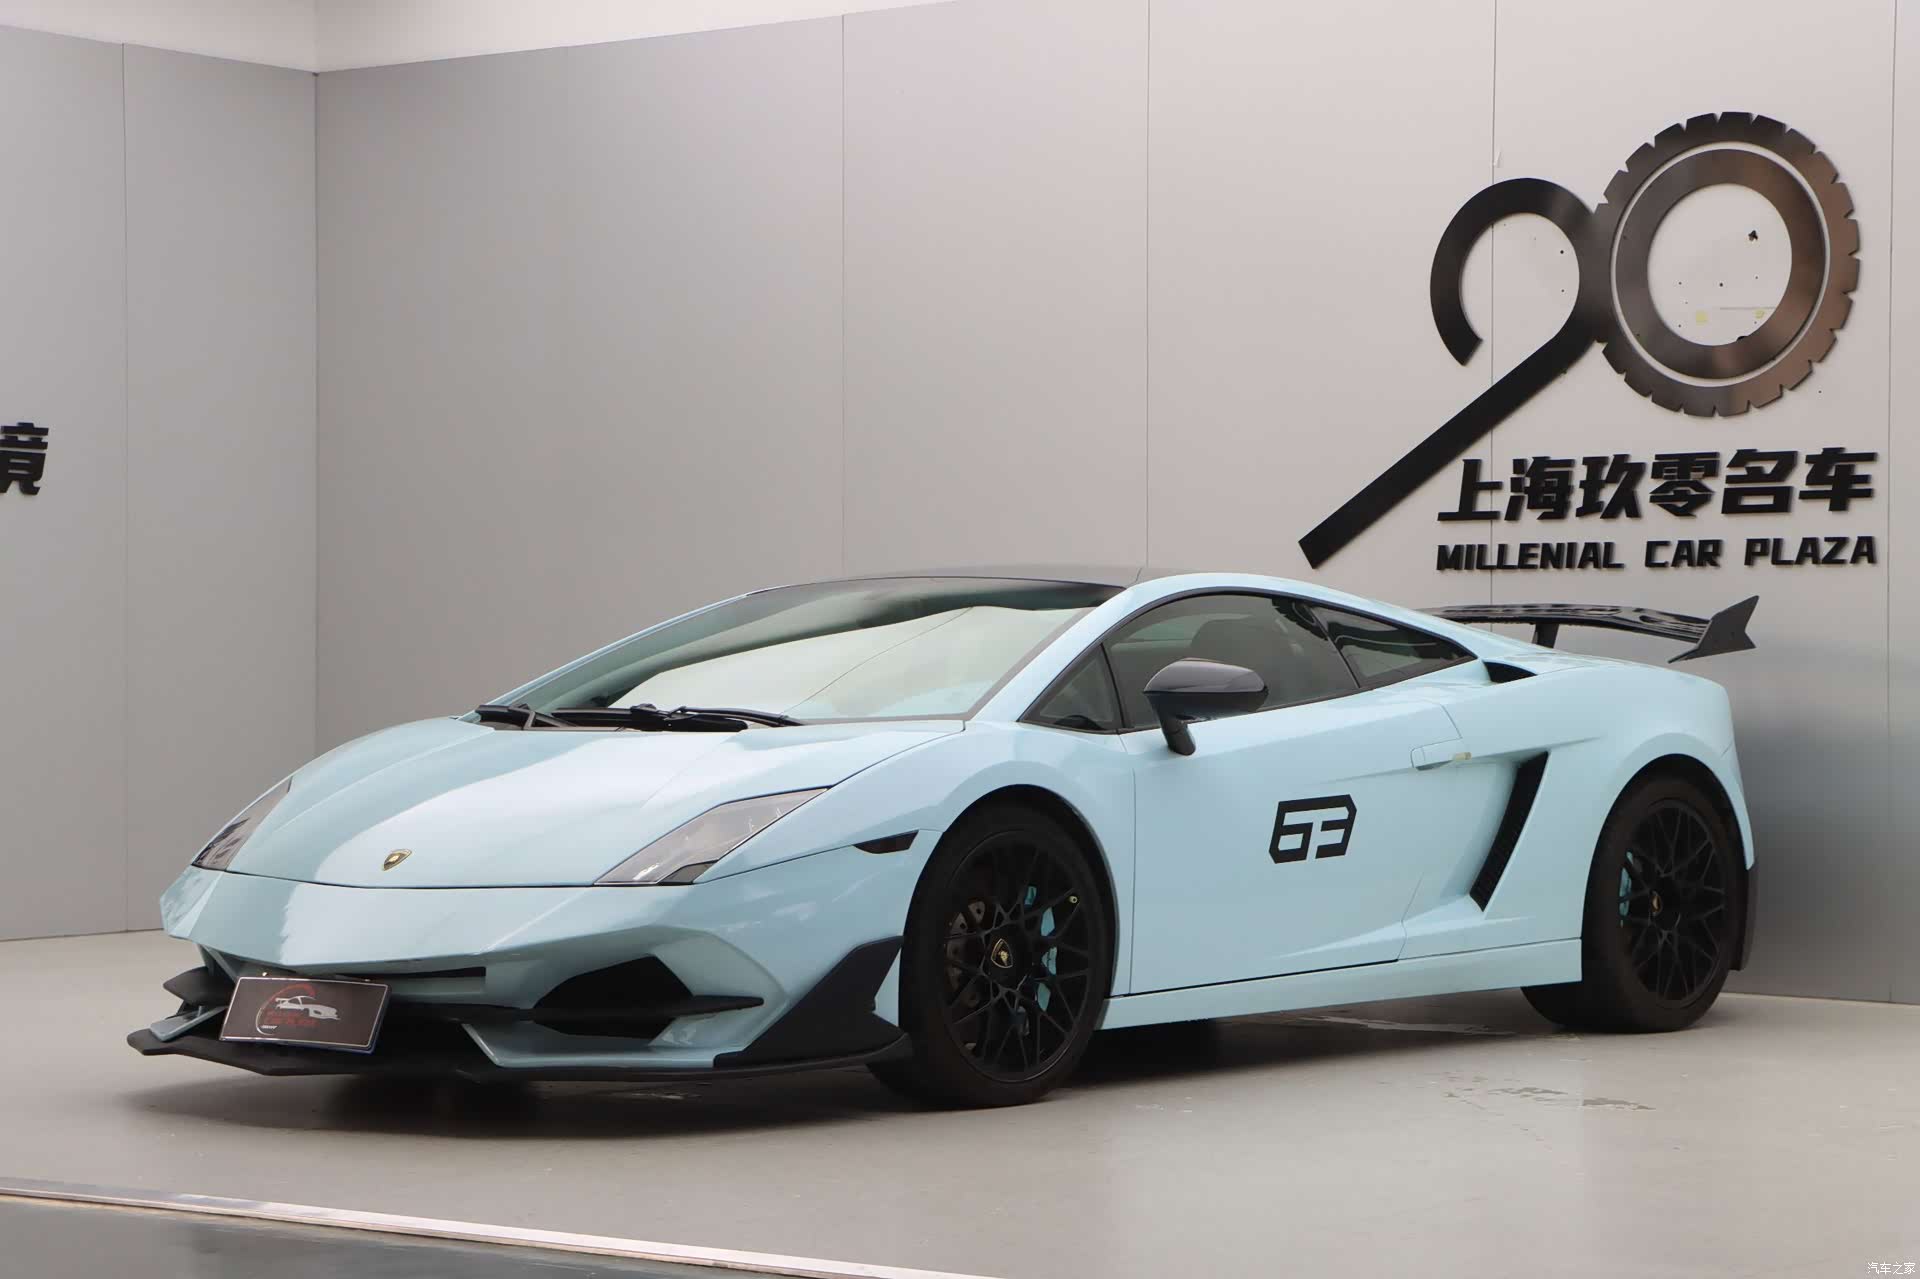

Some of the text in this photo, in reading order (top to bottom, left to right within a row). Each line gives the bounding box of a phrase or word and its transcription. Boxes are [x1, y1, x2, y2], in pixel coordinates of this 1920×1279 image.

[1437, 447, 1878, 521] 上海玖零名车
[1437, 536, 1877, 571] MILLENIAL CAR PLAZA
[1269, 794, 1357, 864] 63
